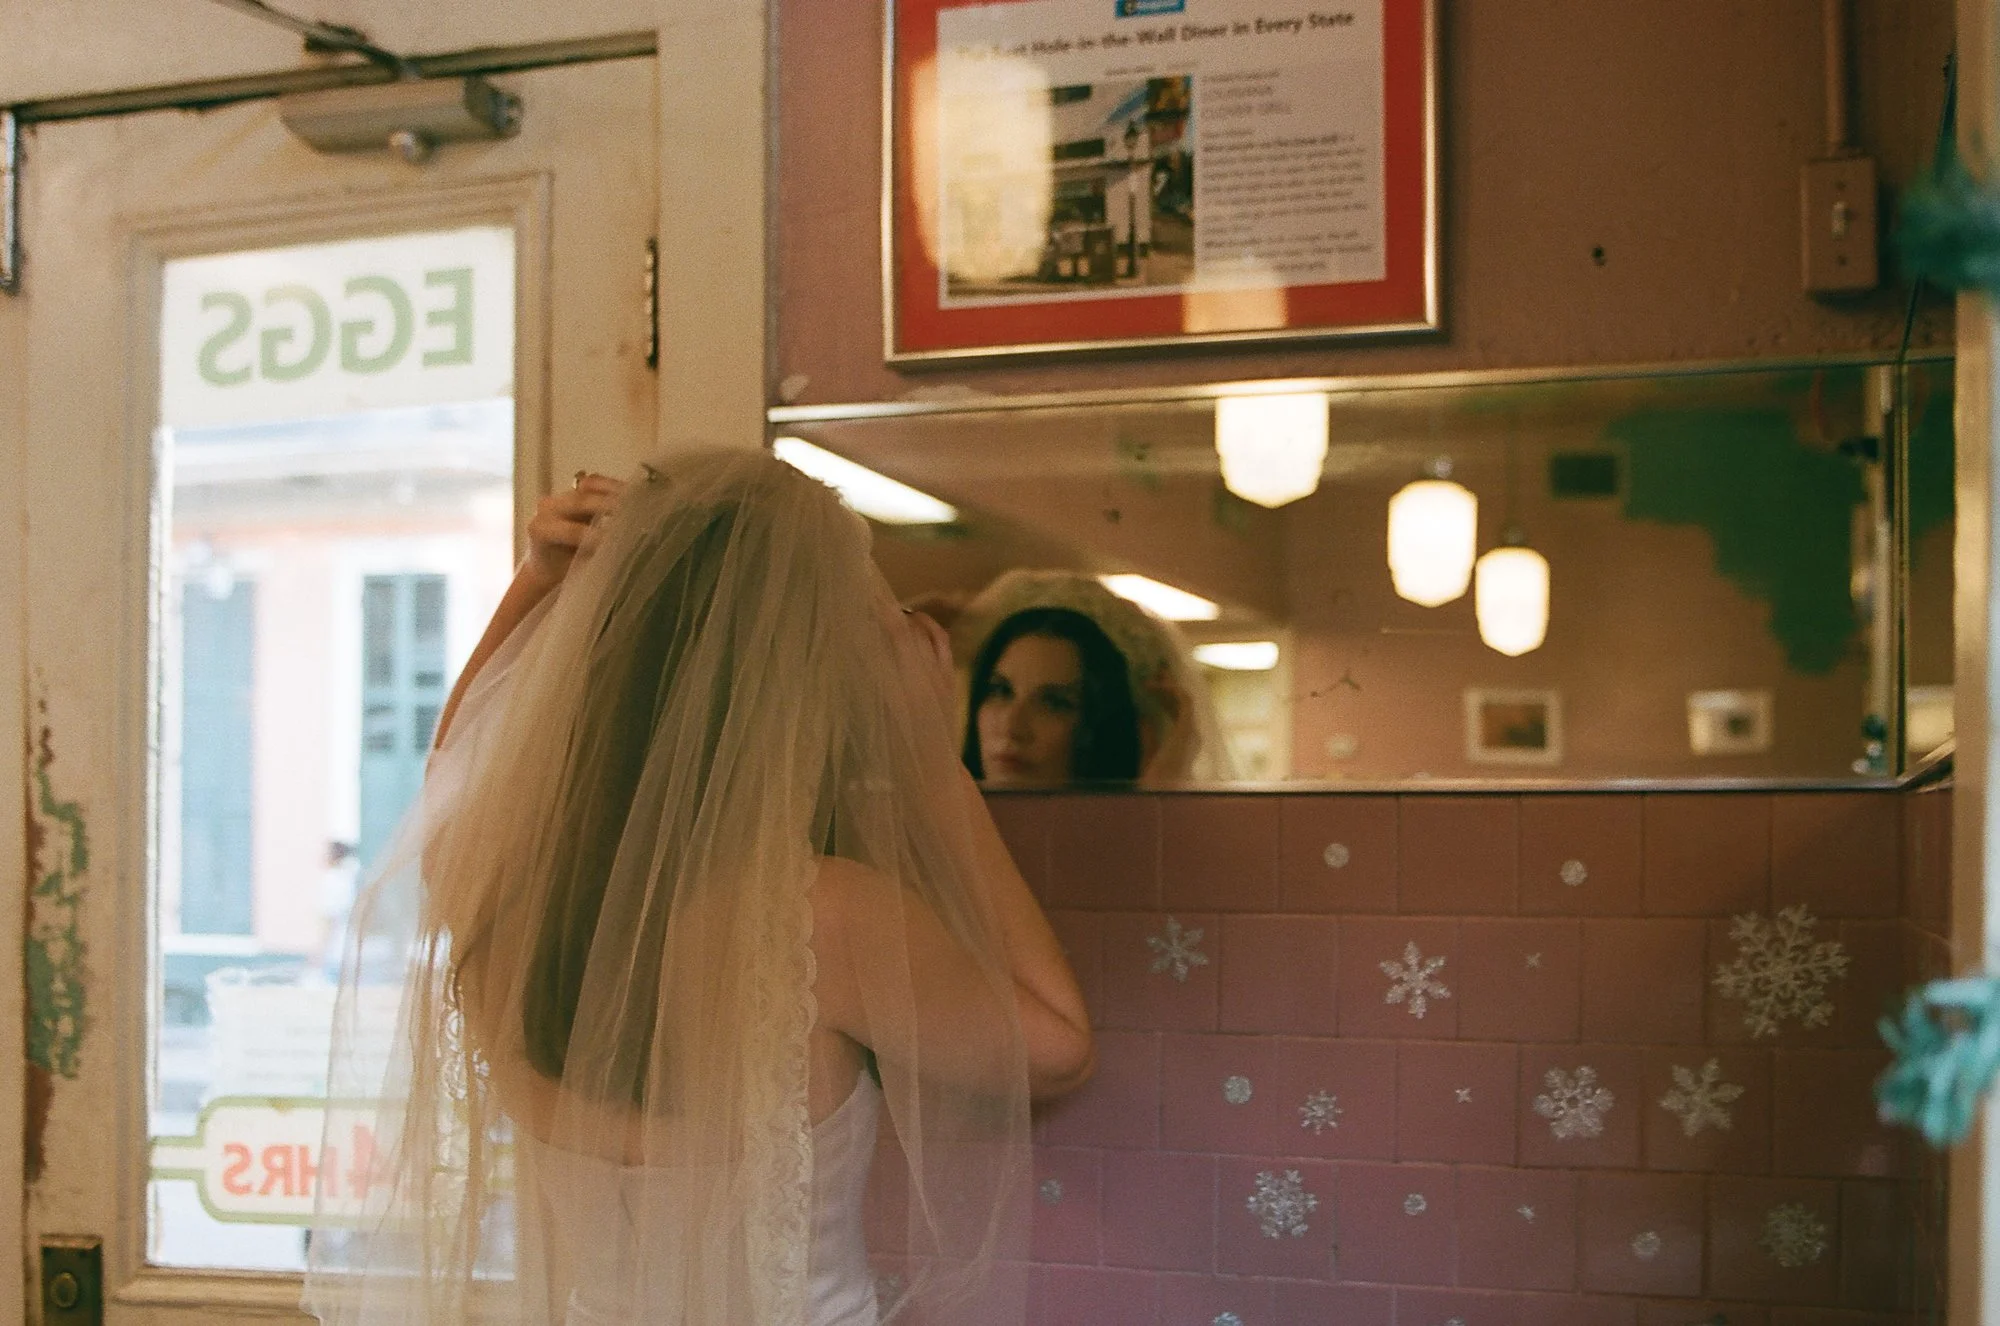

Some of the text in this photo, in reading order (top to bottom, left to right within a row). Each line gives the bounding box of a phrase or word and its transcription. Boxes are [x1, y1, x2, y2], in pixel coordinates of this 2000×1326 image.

[1181, 22, 1227, 41] Diner
[1254, 17, 1303, 36] Every
[1308, 10, 1355, 29] State
